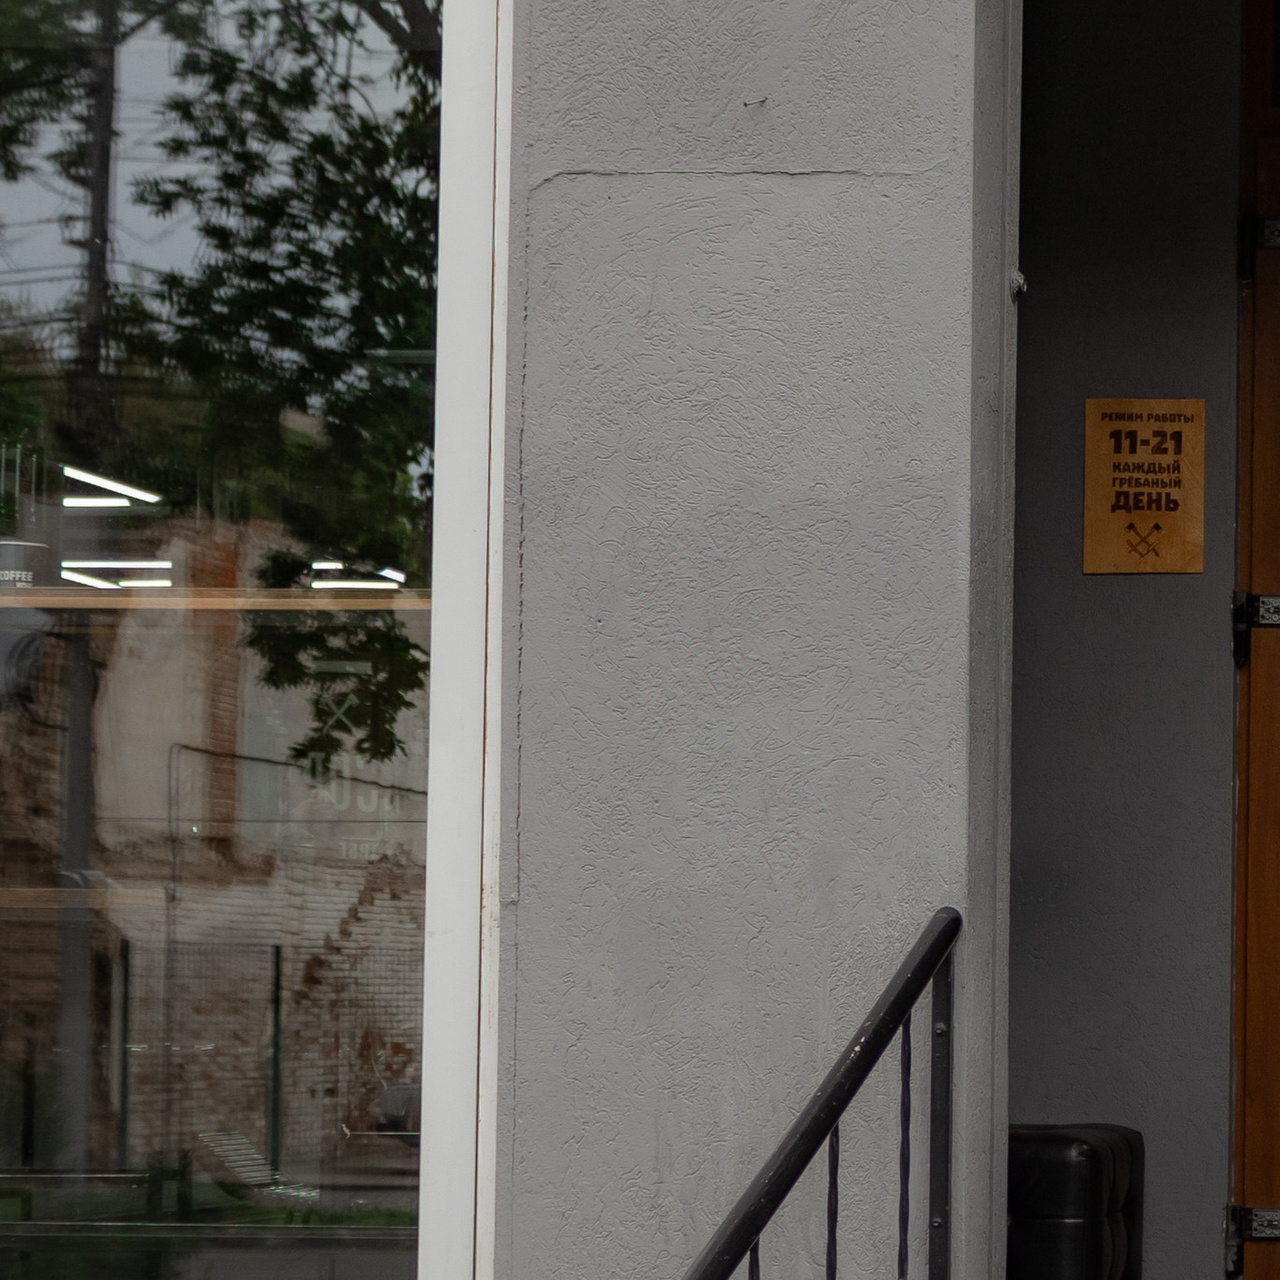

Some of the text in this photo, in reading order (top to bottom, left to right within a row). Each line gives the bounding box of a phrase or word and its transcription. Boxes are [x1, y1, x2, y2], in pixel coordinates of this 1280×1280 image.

[1101, 412, 1194, 423] РЕЖИМ РАБОТЫ
[1109, 429, 1183, 455] 11-21
[1112, 460, 1181, 475] КАЖДЫЙ
[1111, 491, 1180, 513] ДЕНЬ
